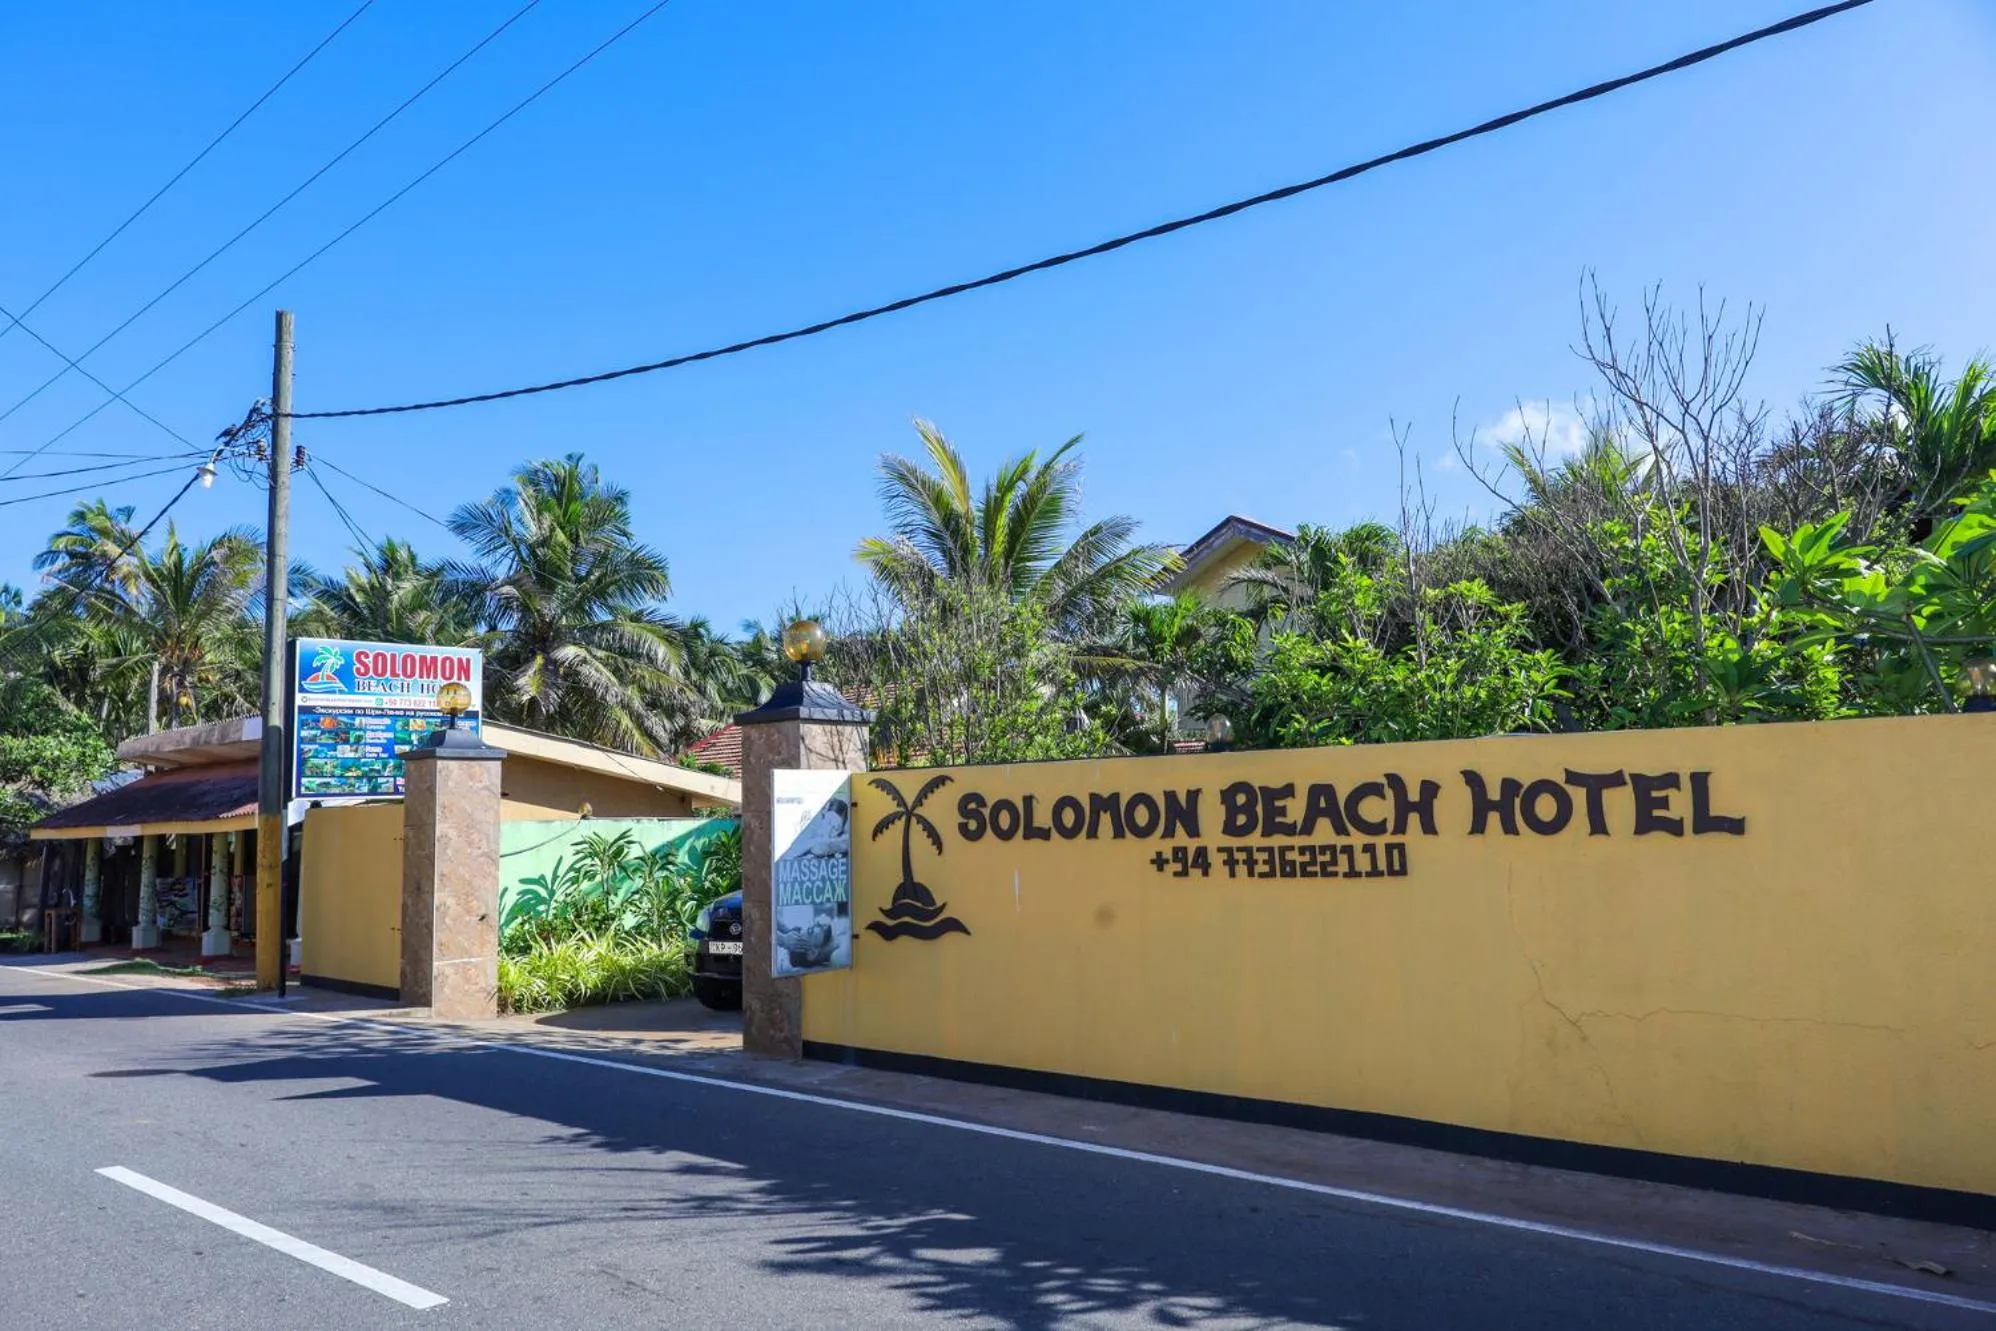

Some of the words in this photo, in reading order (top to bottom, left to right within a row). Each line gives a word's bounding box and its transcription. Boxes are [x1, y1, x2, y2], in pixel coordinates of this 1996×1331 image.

[354, 650, 471, 682] SOLOMON
[356, 680, 411, 693] BEACH
[958, 787, 1202, 842] SOLOMON
[1220, 772, 1441, 839] BEACH
[1460, 768, 1746, 837] HOTEL
[779, 858, 847, 882] MASSAGE
[1150, 845, 1212, 878] +94
[1217, 842, 1408, 879] 773622110
